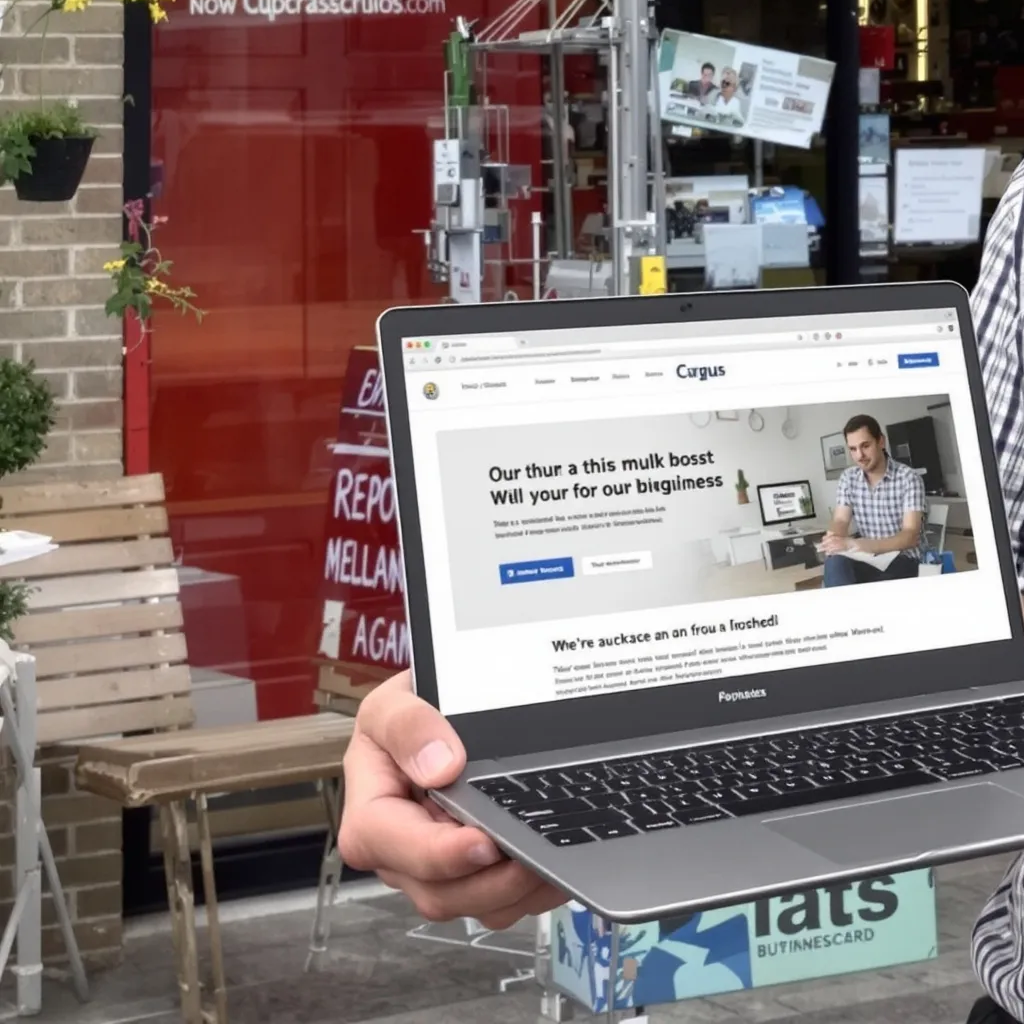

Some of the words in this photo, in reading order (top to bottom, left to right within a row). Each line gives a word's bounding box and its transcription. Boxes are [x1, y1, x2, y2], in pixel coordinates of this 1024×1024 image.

[489, 466, 521, 482] Our
[568, 462, 578, 476] a
[583, 457, 616, 474] this
[622, 453, 664, 472] mulk
[669, 450, 715, 467] bosst
[490, 488, 524, 505] Will
[529, 488, 569, 506] your
[573, 483, 598, 499] for
[603, 482, 632, 497] our
